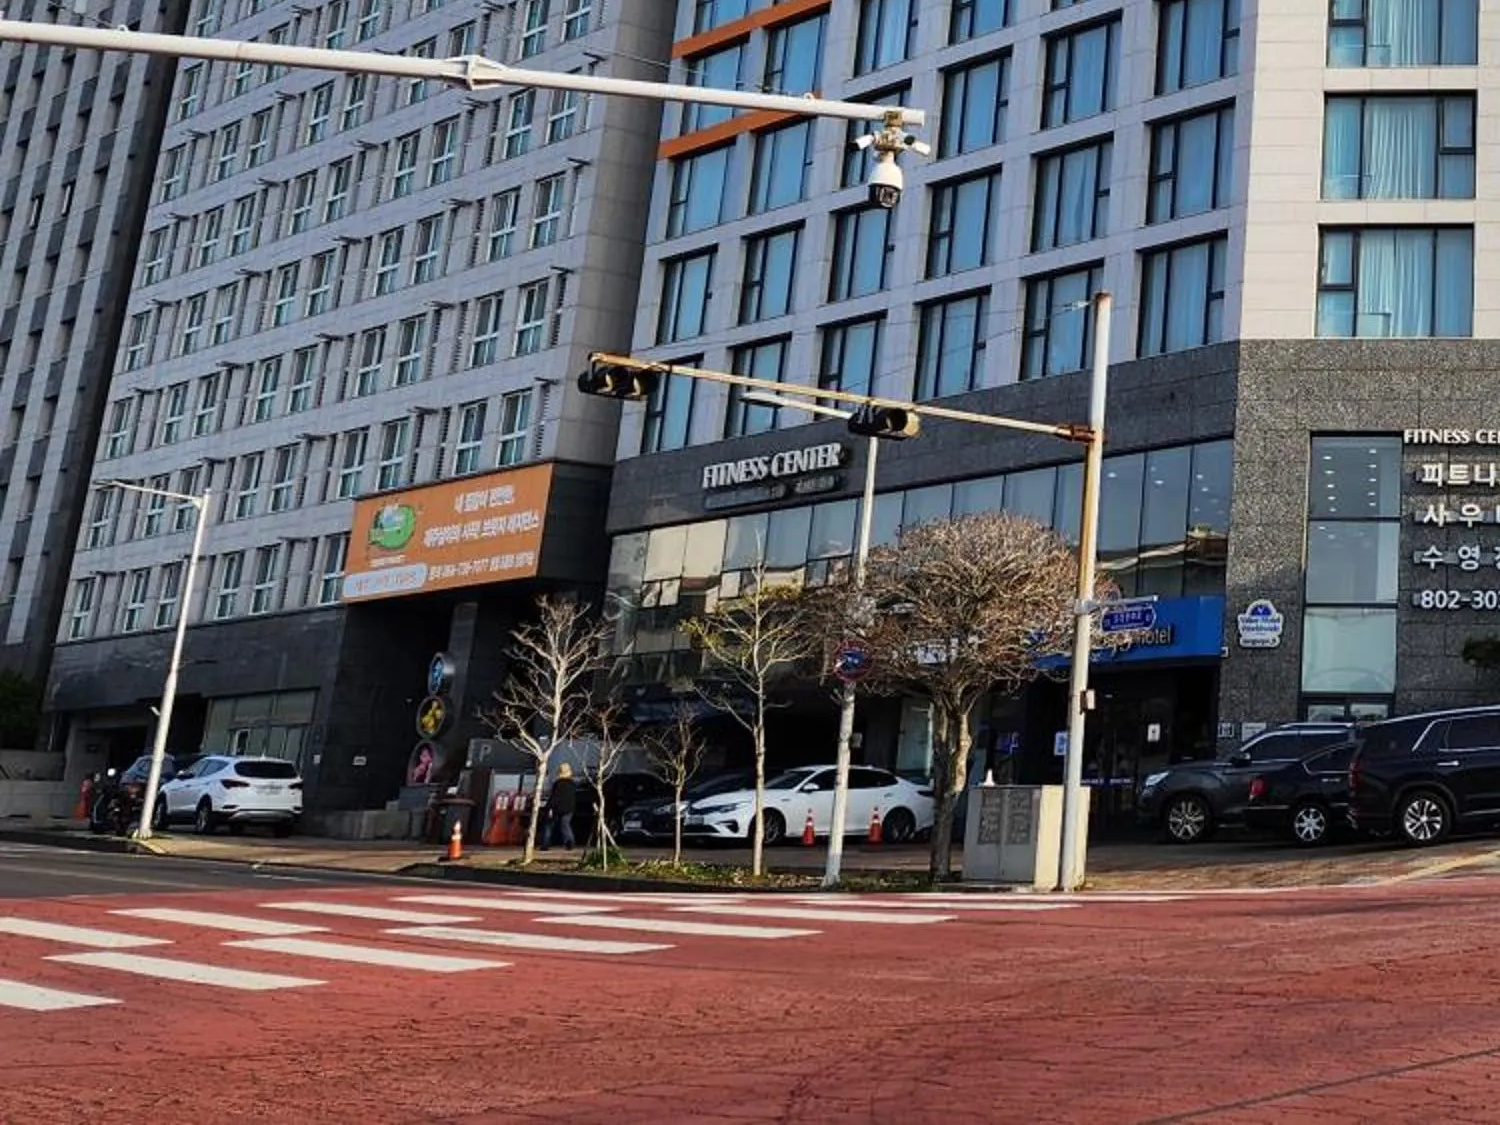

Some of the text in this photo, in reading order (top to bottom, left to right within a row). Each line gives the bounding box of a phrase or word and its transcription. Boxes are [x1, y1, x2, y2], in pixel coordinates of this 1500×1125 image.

[1403, 428, 1471, 444] FITNESS
[702, 455, 770, 488] FITNESS
[771, 442, 842, 477] CENTER
